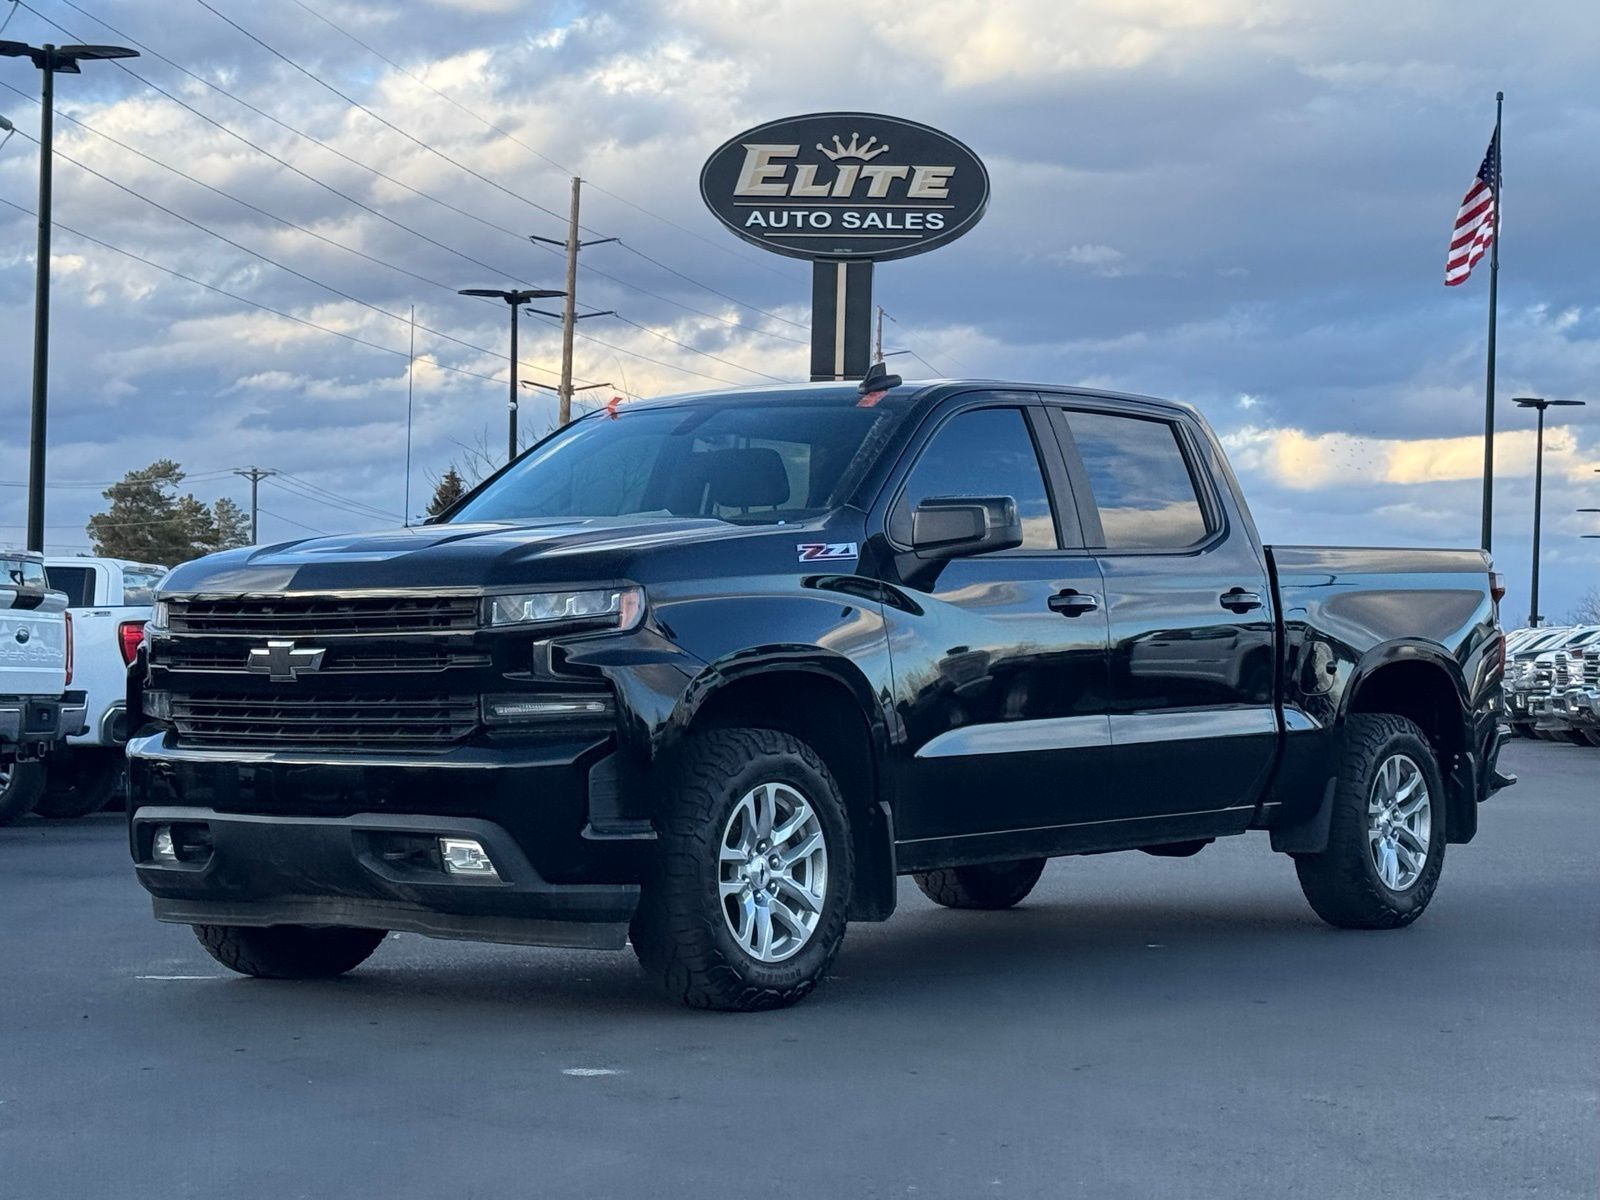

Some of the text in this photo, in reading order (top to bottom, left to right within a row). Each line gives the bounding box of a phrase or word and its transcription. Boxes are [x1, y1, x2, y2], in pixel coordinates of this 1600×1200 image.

[733, 143, 956, 199] ELITE
[745, 210, 945, 230] AUTO SALES
[796, 542, 859, 562] Z71
